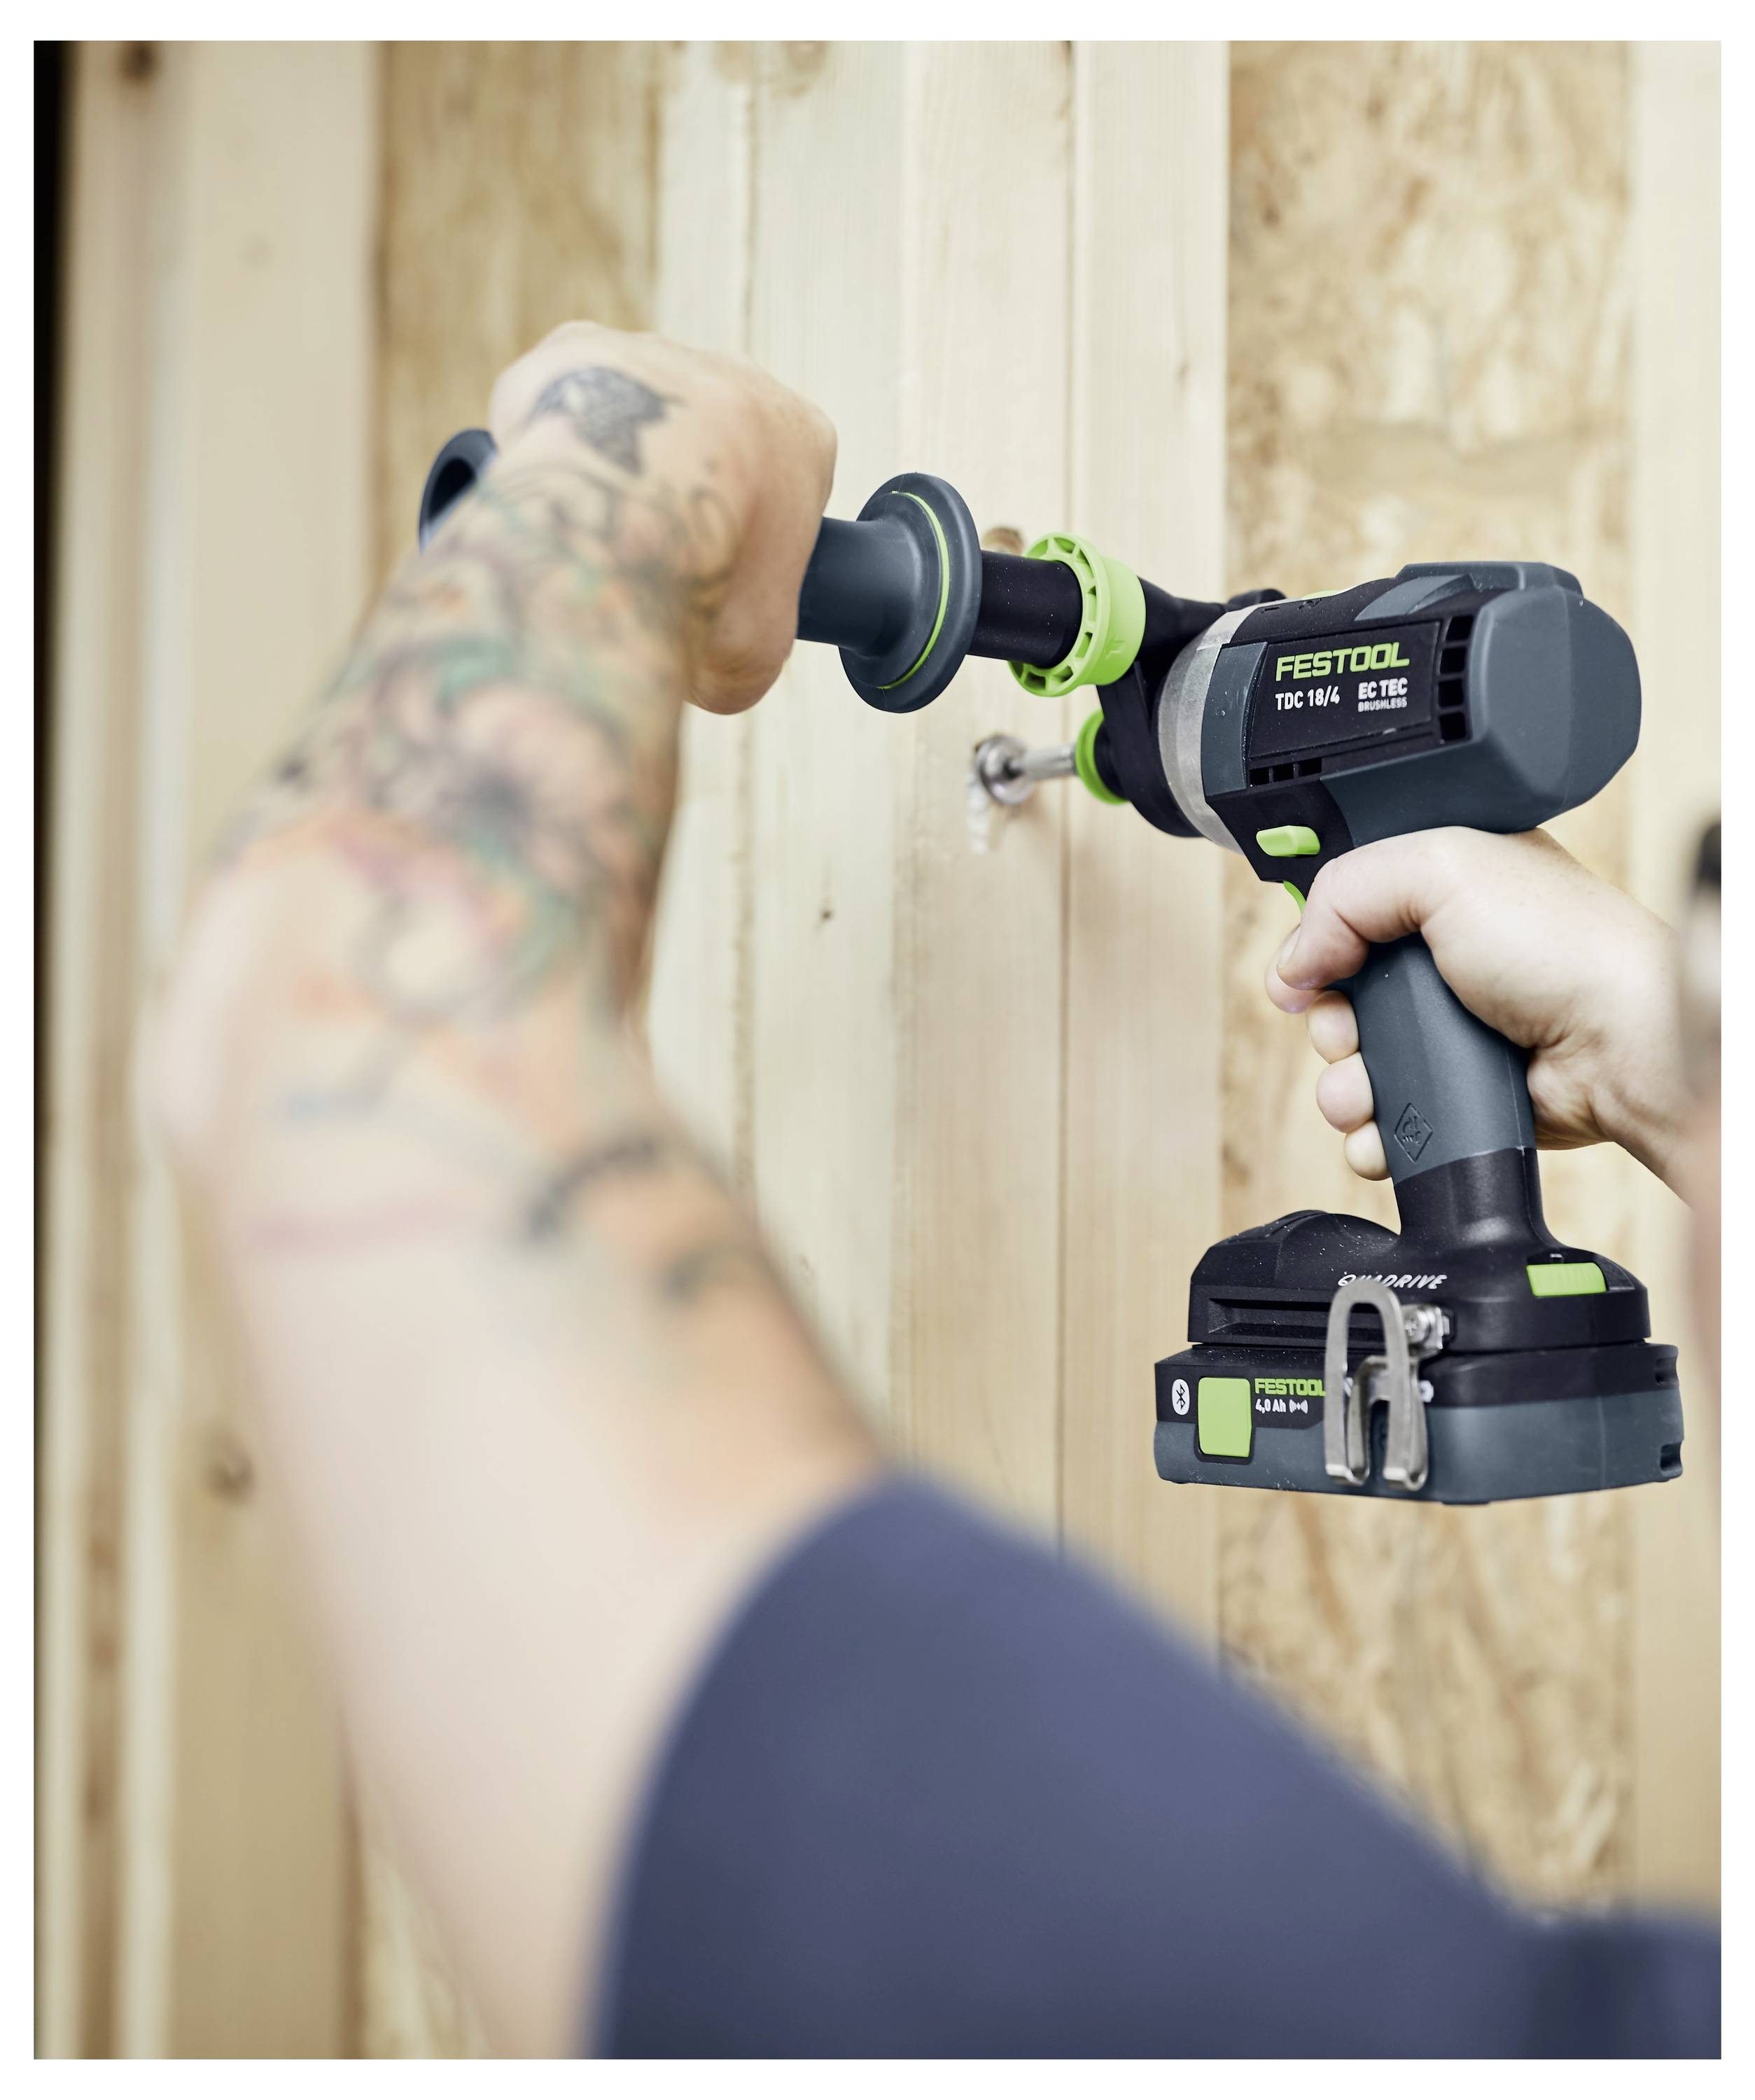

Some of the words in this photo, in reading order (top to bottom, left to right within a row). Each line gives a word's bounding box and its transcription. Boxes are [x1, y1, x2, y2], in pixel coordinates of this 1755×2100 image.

[1275, 642, 1411, 682] FESTOOL
[1275, 690, 1304, 710] TDC
[1307, 685, 1341, 707] 18/4
[1358, 682, 1378, 700] EC
[1378, 678, 1408, 697] TEC
[1357, 696, 1408, 713] BRUSHLESS
[1338, 1274, 1448, 1289] QDRIVE
[1254, 1378, 1327, 1397] FESTOOL
[1255, 1398, 1271, 1414] 4,0
[1272, 1399, 1287, 1413] Ah
